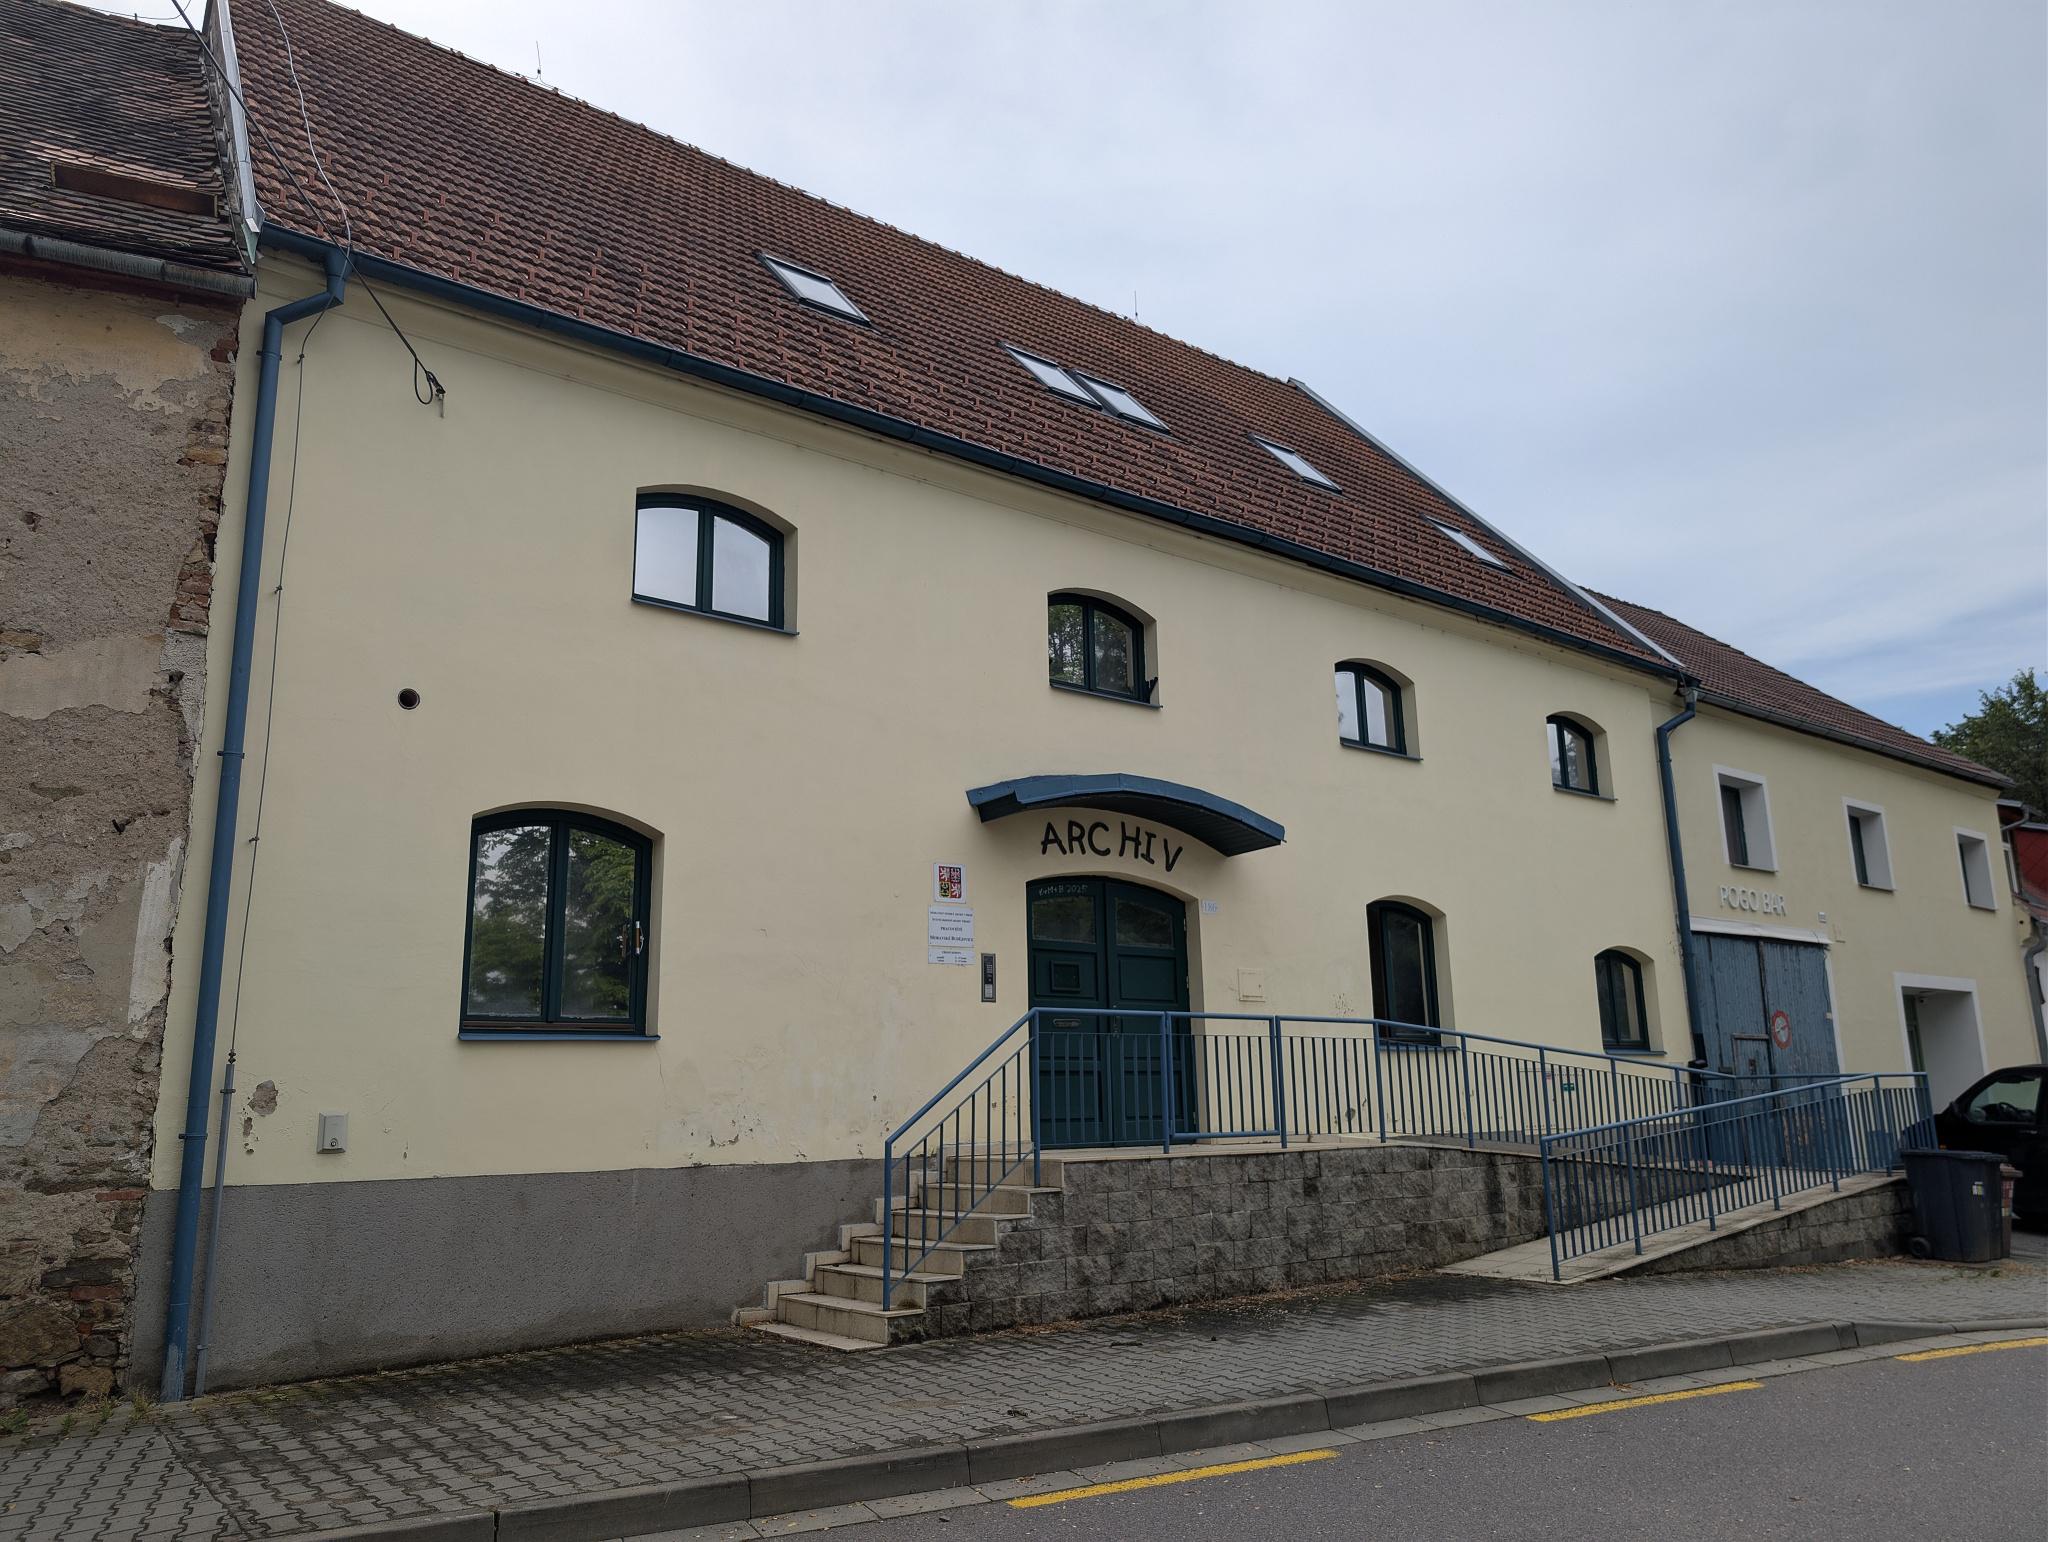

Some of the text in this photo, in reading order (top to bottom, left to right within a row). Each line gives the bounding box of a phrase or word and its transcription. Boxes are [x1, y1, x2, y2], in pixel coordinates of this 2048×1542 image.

[1040, 819, 1184, 873] ARCHIV
[1719, 884, 1787, 916] POGO BAR
